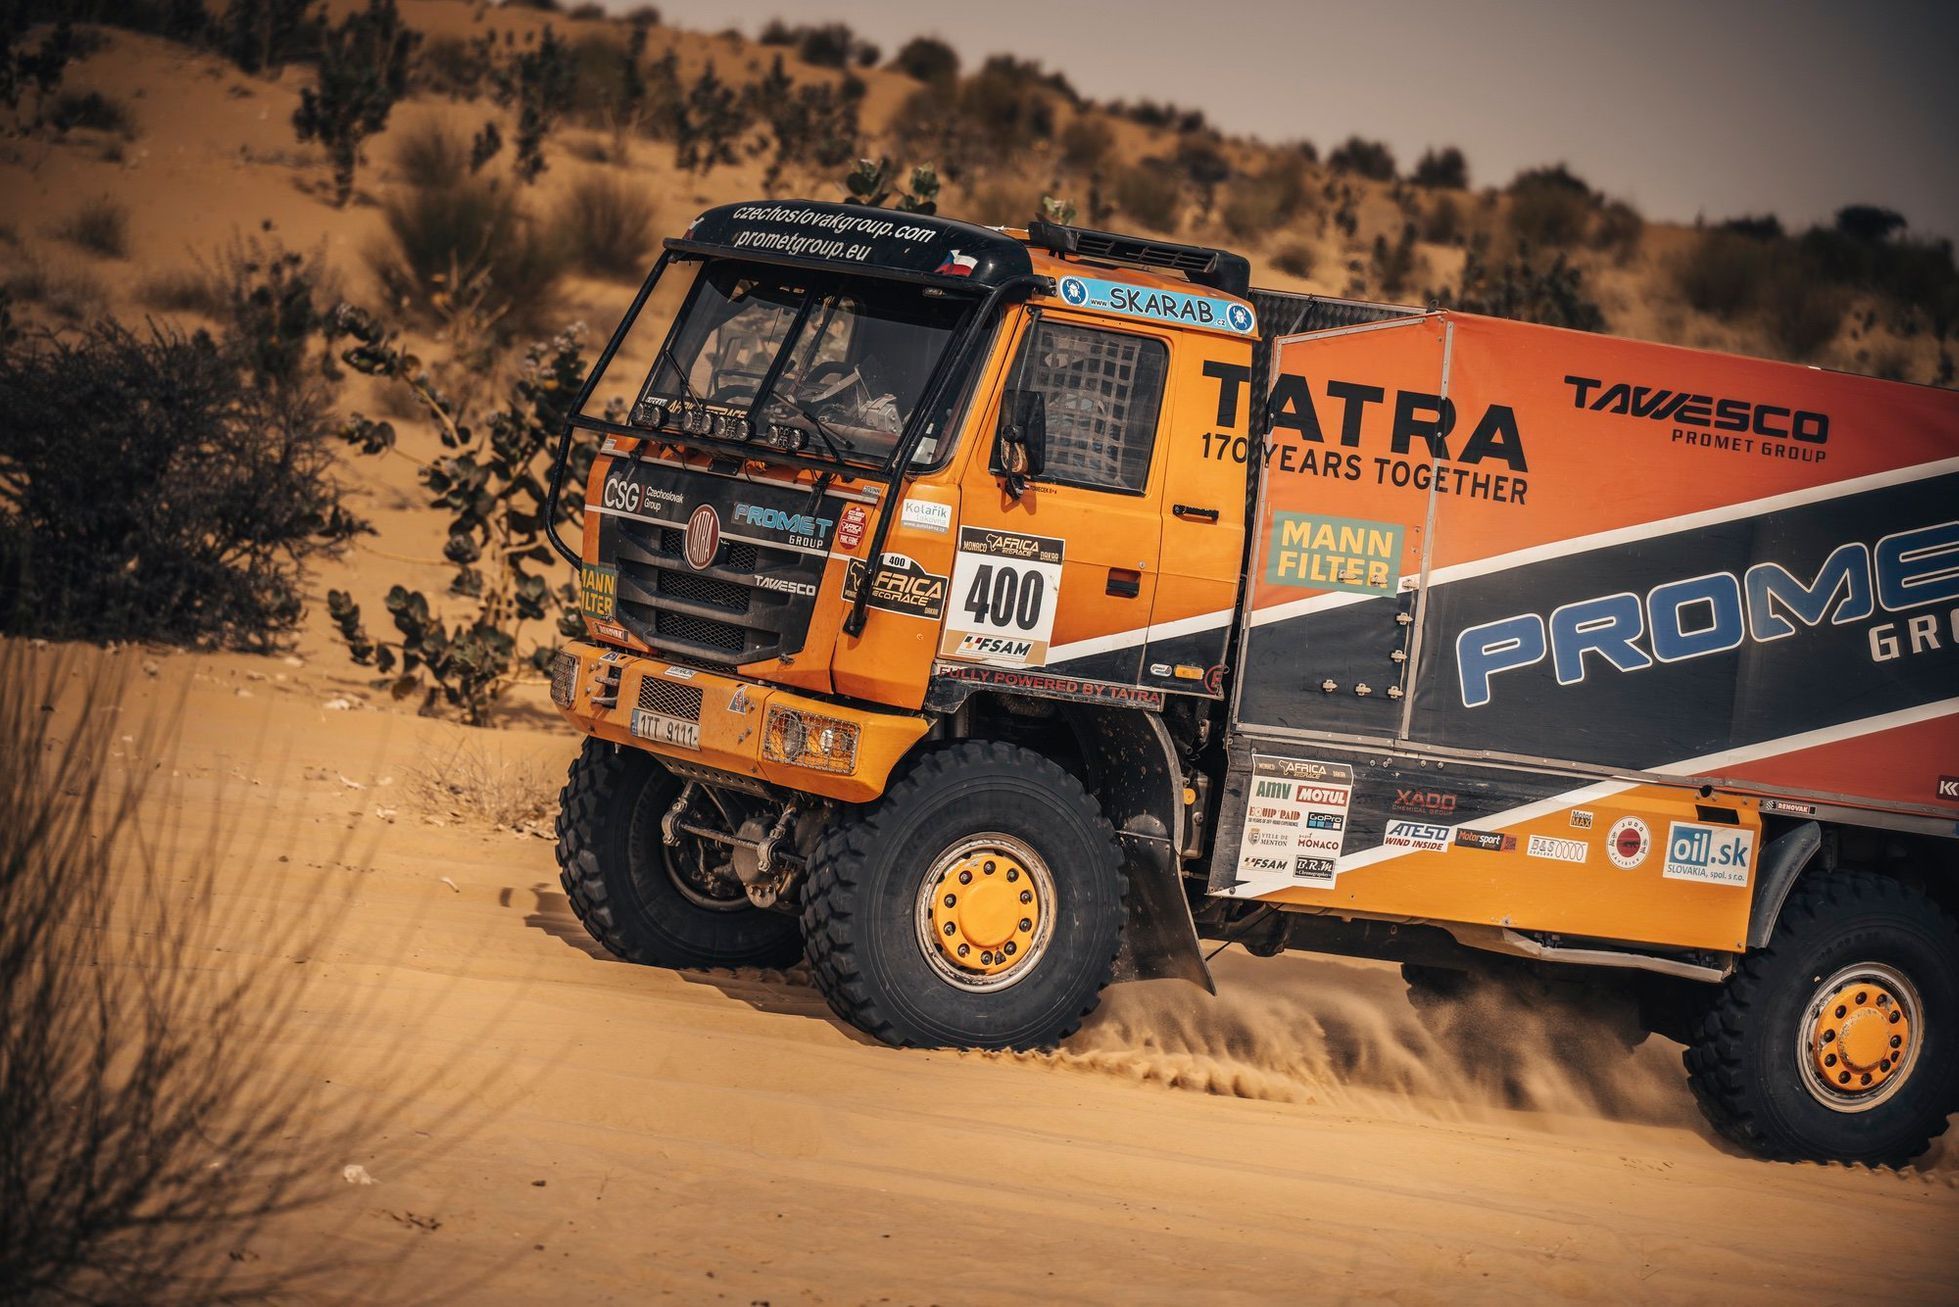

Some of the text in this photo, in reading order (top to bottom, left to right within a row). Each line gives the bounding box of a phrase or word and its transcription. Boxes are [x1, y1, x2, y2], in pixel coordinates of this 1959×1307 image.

[733, 205, 937, 244] czechoslovakgroup.com
[734, 230, 872, 262] prometgroup.eu
[1109, 287, 1214, 323] SKARAB
[1202, 360, 1528, 474] TATRA
[1564, 375, 1830, 445] TAWESCO
[1671, 428, 1827, 464] PROMET GROUP
[1202, 432, 1528, 505] 170 YEARS TOGETHER
[604, 478, 640, 512] CSG
[644, 498, 662, 512] Group
[646, 486, 684, 504] Czechoslovak
[734, 503, 834, 538] PROMET
[905, 502, 947, 518] Kolařík
[689, 510, 714, 563] TATRA
[788, 534, 824, 549] GROUP
[963, 541, 988, 553] MONACO
[992, 536, 1039, 553] AFRICA
[1281, 519, 1394, 558] MANN
[888, 556, 906, 567] 400
[1277, 551, 1391, 590] FILTER
[754, 574, 817, 597] TAWESCO
[873, 570, 943, 600] FRICA
[581, 590, 613, 616] ILTER
[963, 564, 1045, 631] 400
[1456, 520, 1959, 708] PROME
[977, 637, 1032, 656] FSAM
[940, 665, 1160, 704] FULLY POWERED BY TATRA
[640, 714, 693, 746] 1TT 9111
[1286, 761, 1327, 775] AFRICA
[1298, 787, 1346, 804] MOTUL
[1394, 788, 1457, 810] XADO
[1309, 813, 1342, 823] GoPro
[1571, 816, 1591, 827] MAX
[1260, 839, 1288, 847] MENTON
[1297, 838, 1339, 850] MONACO
[1385, 837, 1444, 850] WIND INSIDE
[1458, 829, 1501, 847] Motorsport
[1673, 832, 1748, 867] oil.sk
[1254, 858, 1288, 870] FSAM
[1667, 864, 1709, 879] SLOVAKIA,
[1710, 871, 1727, 880] spol.
